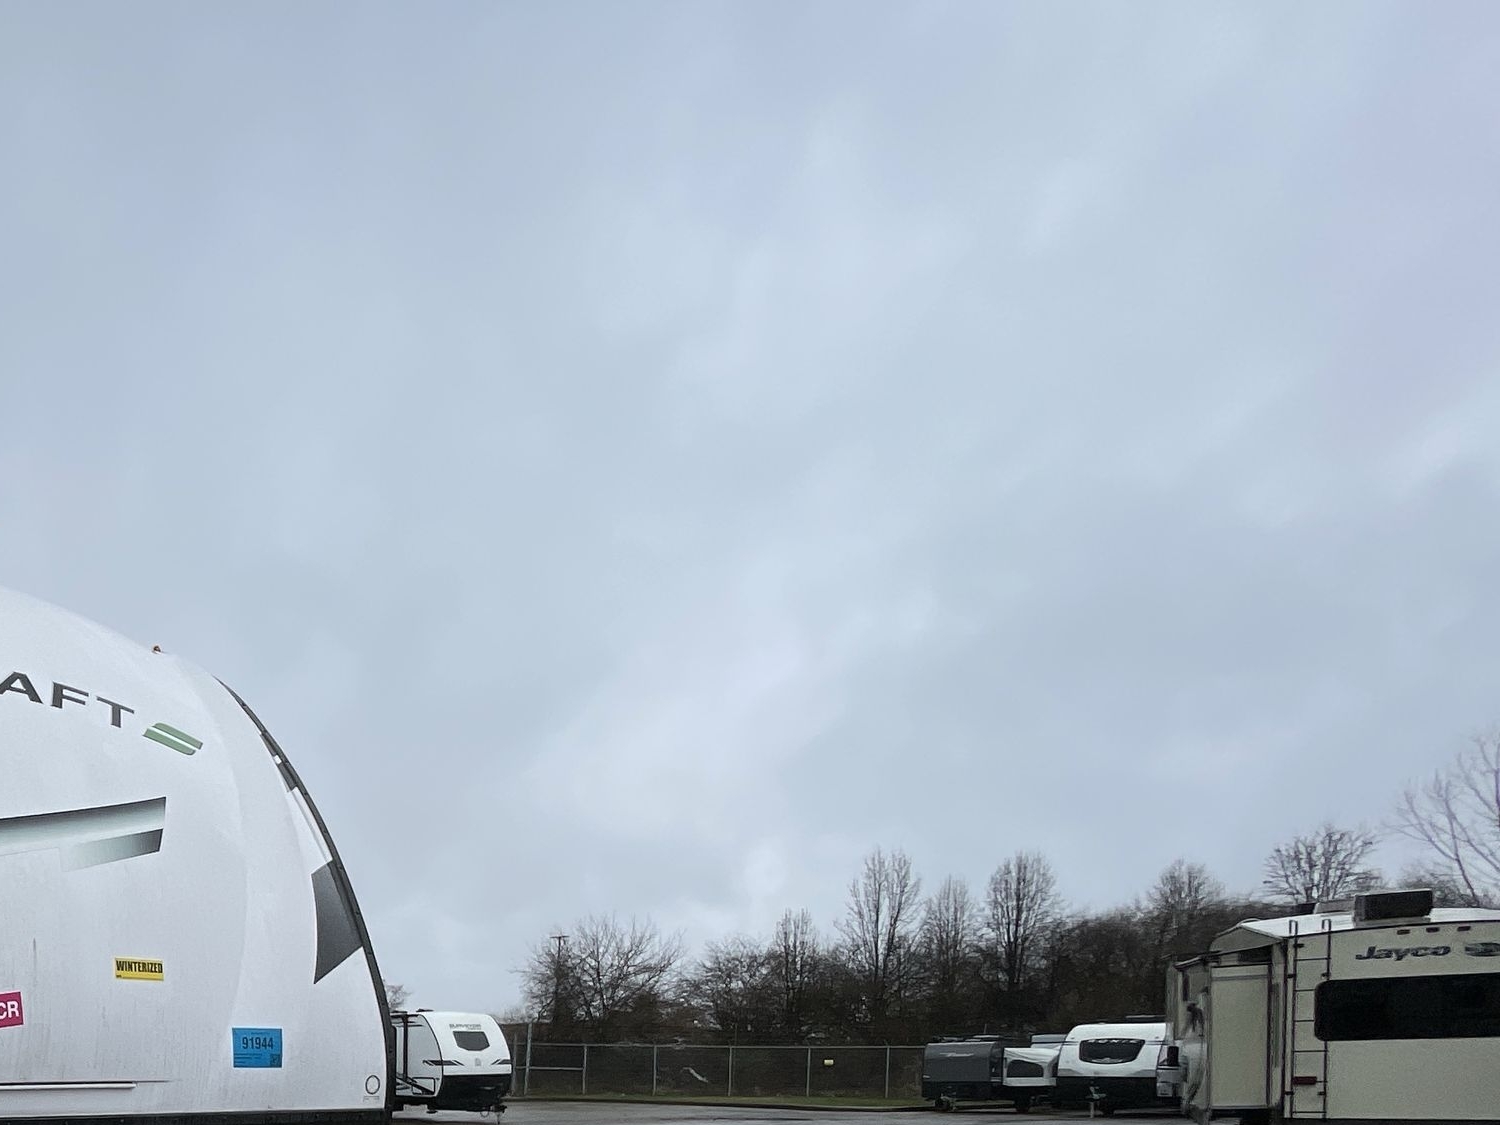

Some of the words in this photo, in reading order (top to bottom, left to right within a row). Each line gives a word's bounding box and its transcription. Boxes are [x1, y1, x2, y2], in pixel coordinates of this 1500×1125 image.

[1355, 946, 1451, 961] Jayco
[116, 960, 163, 973] WINTERIZED
[242, 1036, 274, 1050] 91944
